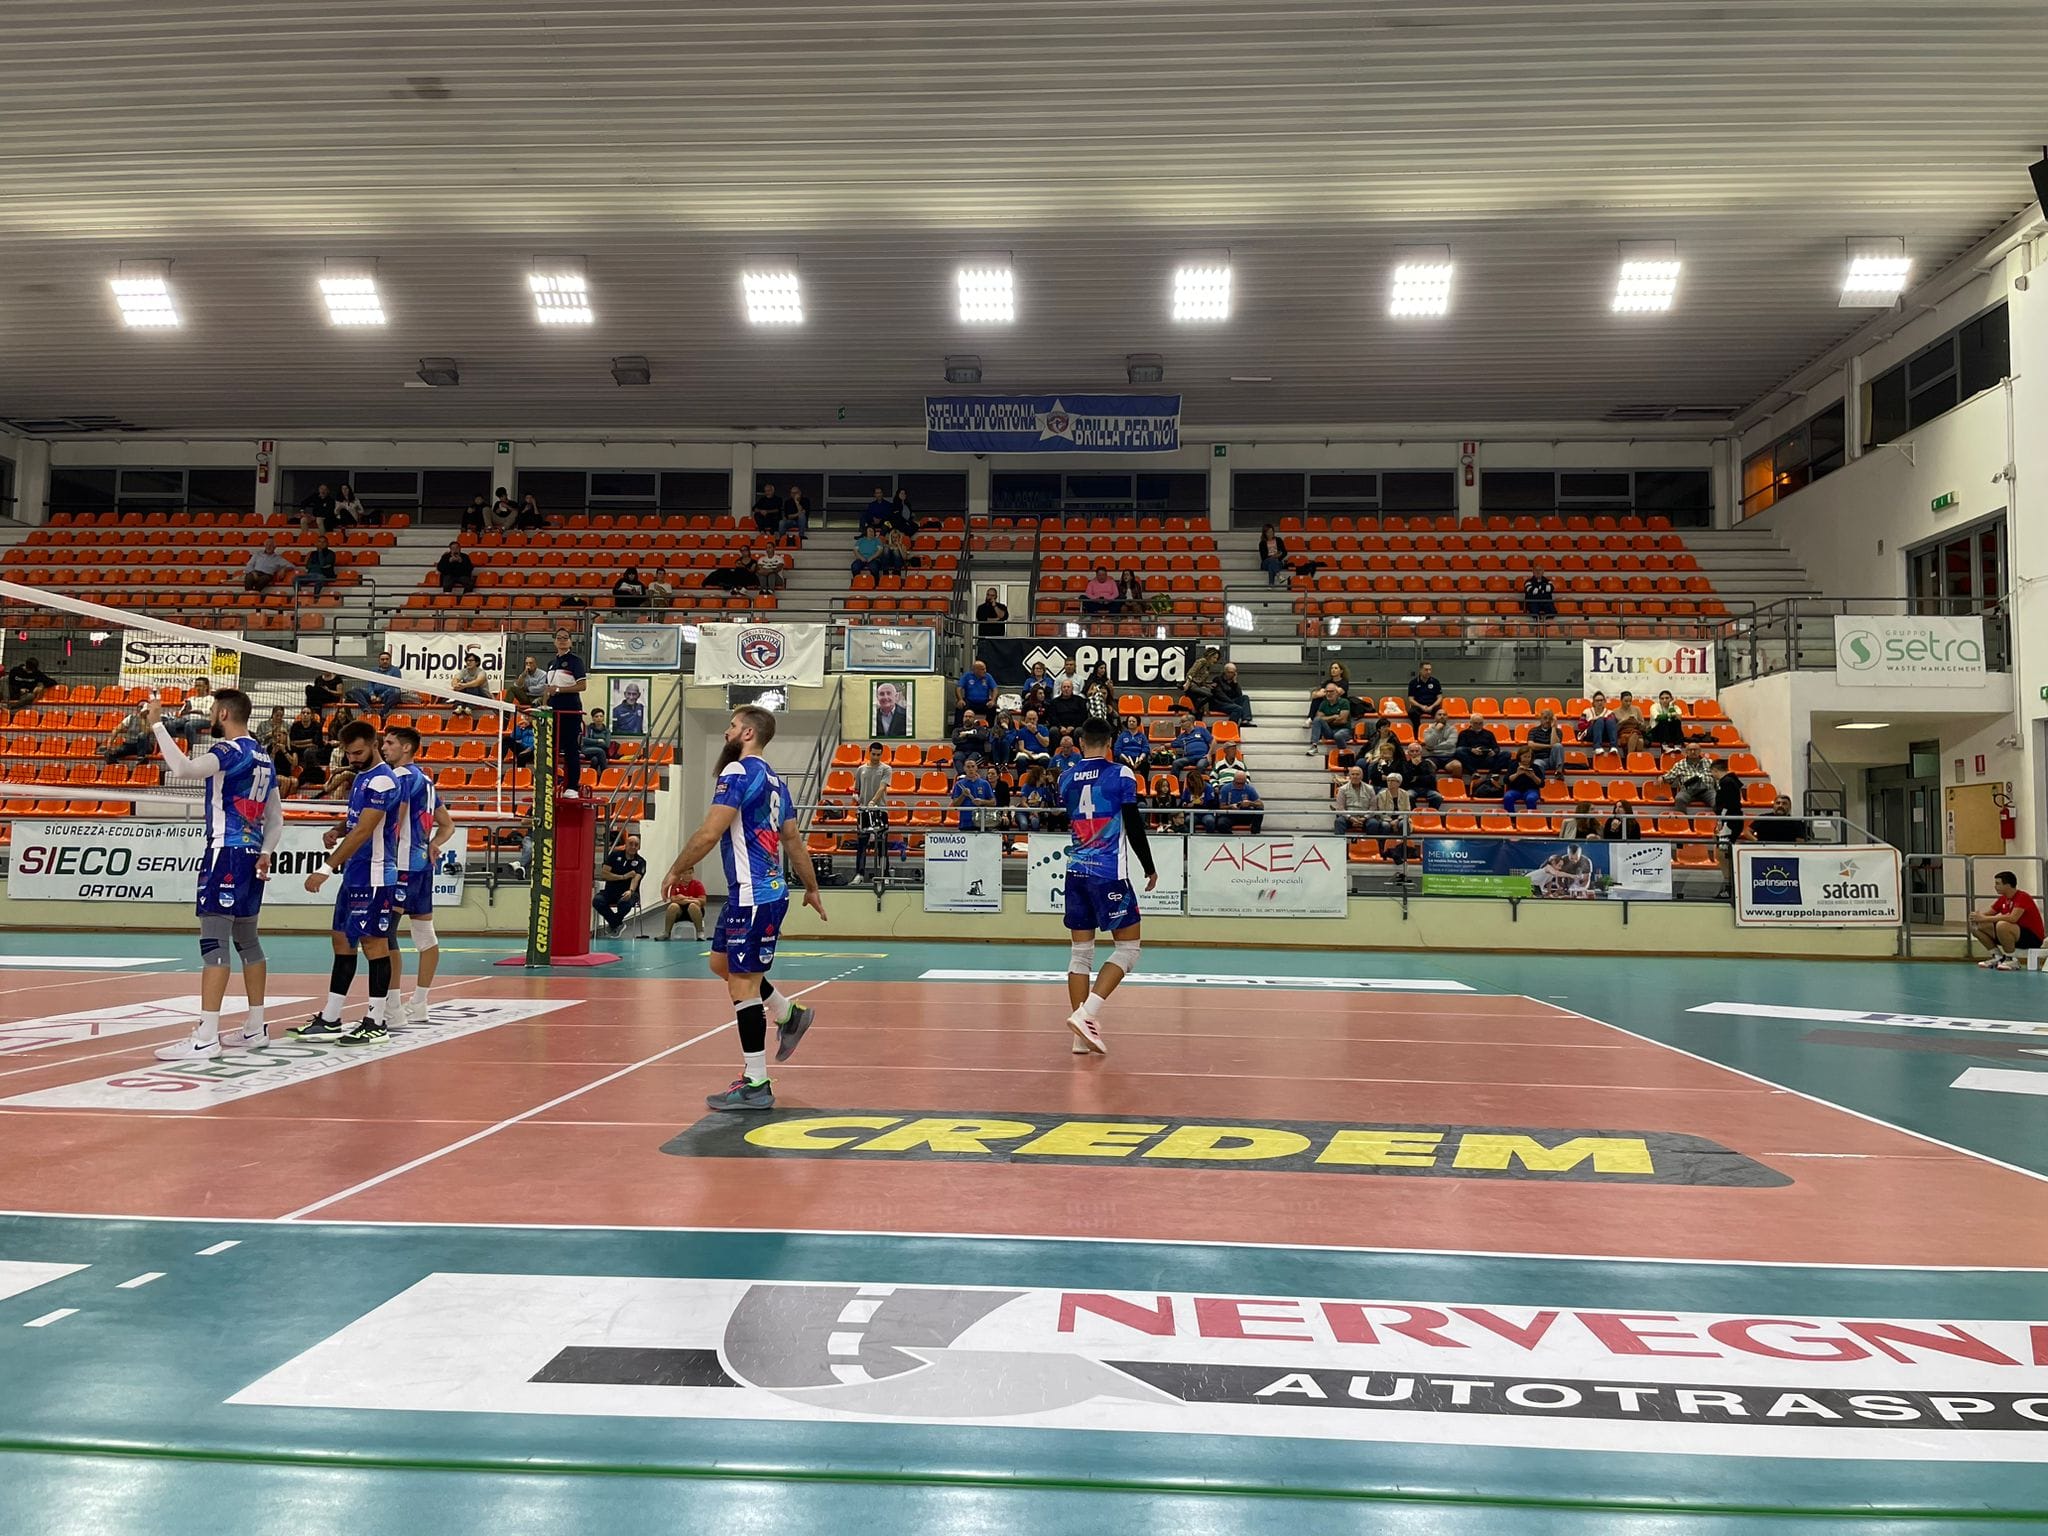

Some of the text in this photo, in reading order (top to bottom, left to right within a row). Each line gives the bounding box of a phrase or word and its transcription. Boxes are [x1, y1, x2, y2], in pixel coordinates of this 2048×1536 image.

[928, 404, 969, 430] STELLA
[989, 404, 1036, 430] ORTONA
[1125, 420, 1149, 446] PER
[1590, 646, 1709, 674] Eurofil
[1886, 631, 1981, 661] setra
[546, 717, 554, 768] BANCA
[248, 765, 272, 803] 15
[1073, 769, 1099, 782] CAPELLI
[544, 773, 553, 830] CREDEM
[1079, 784, 1096, 820] 4
[929, 836, 966, 844] TOMMASO
[19, 846, 132, 876] SIECO
[137, 857, 206, 872] SERVIC
[541, 838, 554, 889] BANCA
[1204, 842, 1331, 873] AKEA
[78, 884, 154, 898] ORTONA
[1271, 876, 1303, 885] speciali
[1753, 878, 1799, 888] partinsieme
[1822, 881, 1880, 899] satam
[536, 894, 551, 953] CREDEM
[1746, 908, 1896, 918] www.gruppolapanoramica.it
[107, 1046, 328, 1093] SIECO
[743, 1114, 1656, 1177] CREDEM
